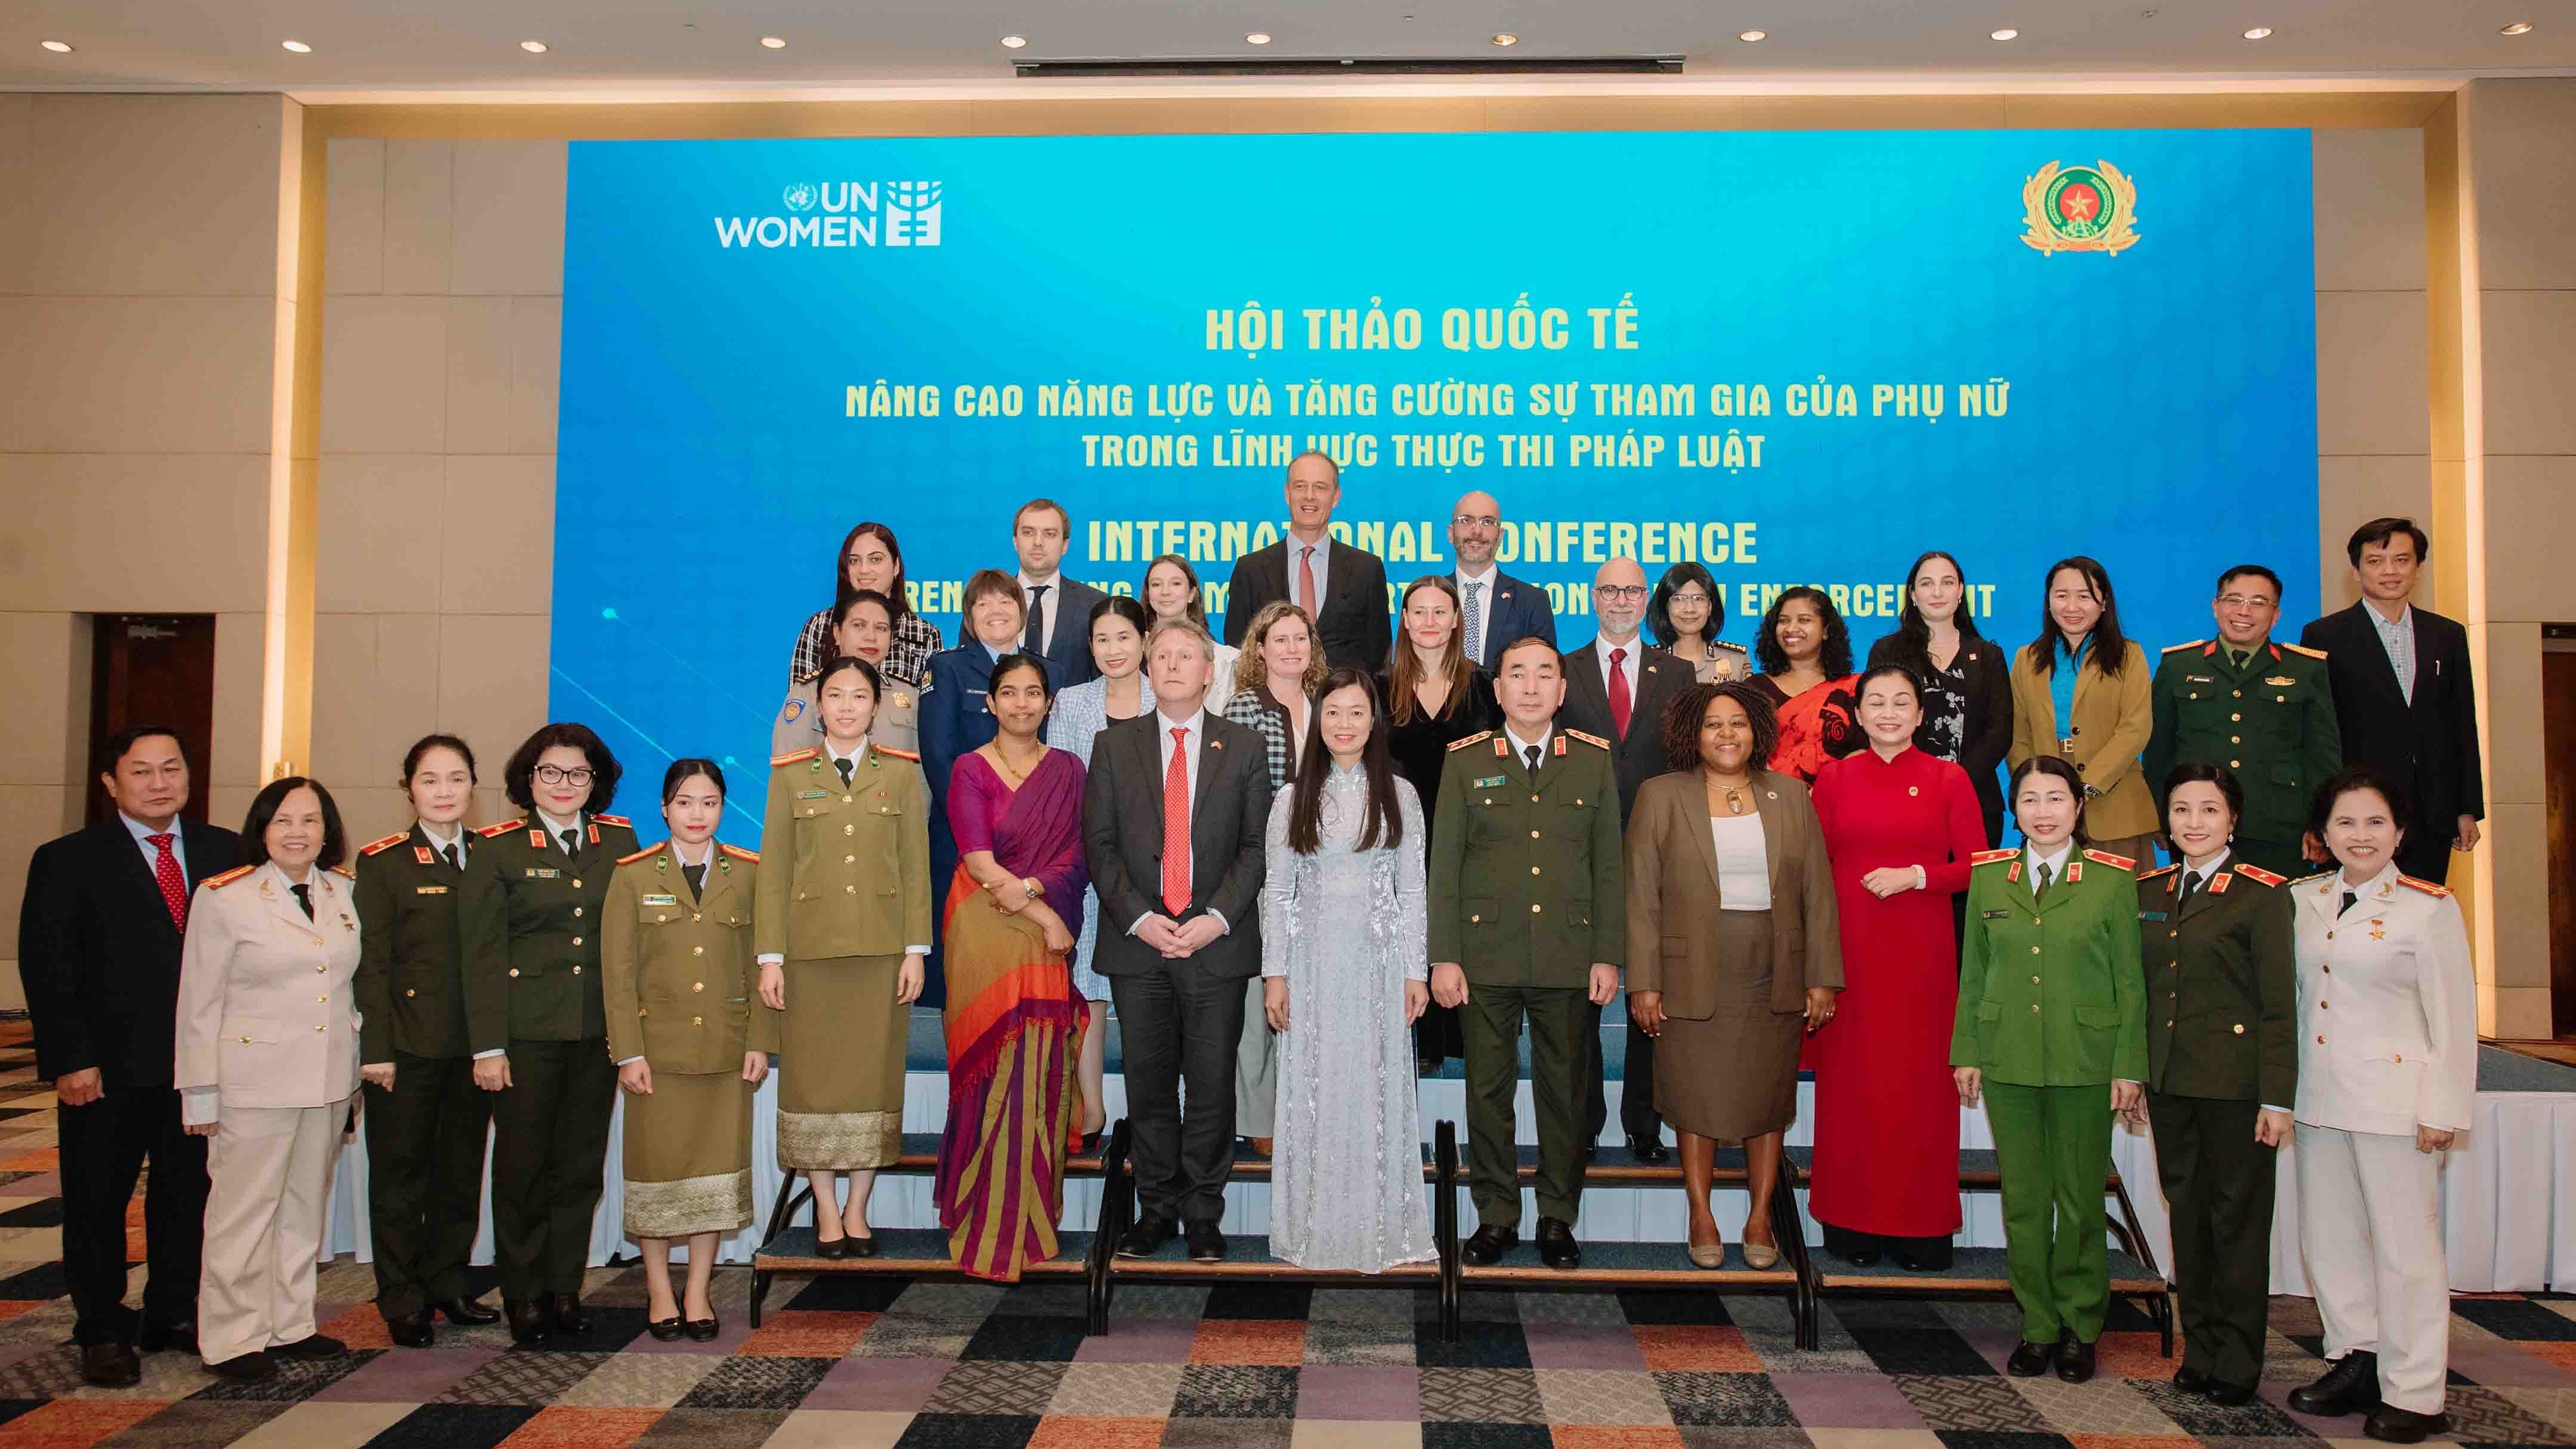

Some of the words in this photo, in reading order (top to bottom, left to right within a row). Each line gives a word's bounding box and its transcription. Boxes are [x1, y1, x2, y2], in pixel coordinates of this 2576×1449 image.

[821, 182, 877, 212] UN
[714, 217, 876, 248] WOMEN
[1207, 301, 1282, 358] HỘI
[1303, 296, 1421, 350] THẢO
[1443, 293, 1568, 351] QUỐC
[1588, 293, 1638, 349] TẾ
[846, 380, 939, 416] NÂNG
[955, 385, 1022, 416] CAO
[1038, 379, 1132, 416] NĂNG
[1149, 382, 1212, 422] LỰC
[1228, 378, 1270, 416] VÀ
[1286, 379, 1376, 416] TĂNG
[1393, 378, 1513, 416] CƯỜNG
[1530, 382, 1578, 422] SỰ
[1591, 385, 1694, 416] THAM
[1711, 385, 1770, 416] GIA
[1787, 375, 1857, 416] CỦA
[1873, 385, 1943, 422] PHỤ
[1960, 378, 2009, 416] NỮ
[1083, 435, 1197, 466] TRONG
[1213, 429, 1292, 466] LĨNH
[1391, 432, 1483, 473] THỰC
[1498, 435, 1554, 466] THI
[1571, 430, 1664, 466] PHÁP
[1679, 429, 1764, 473] LUẬT
[1088, 521, 1443, 561] INTERNAONAL
[1496, 521, 1756, 563] ONFERENCE
